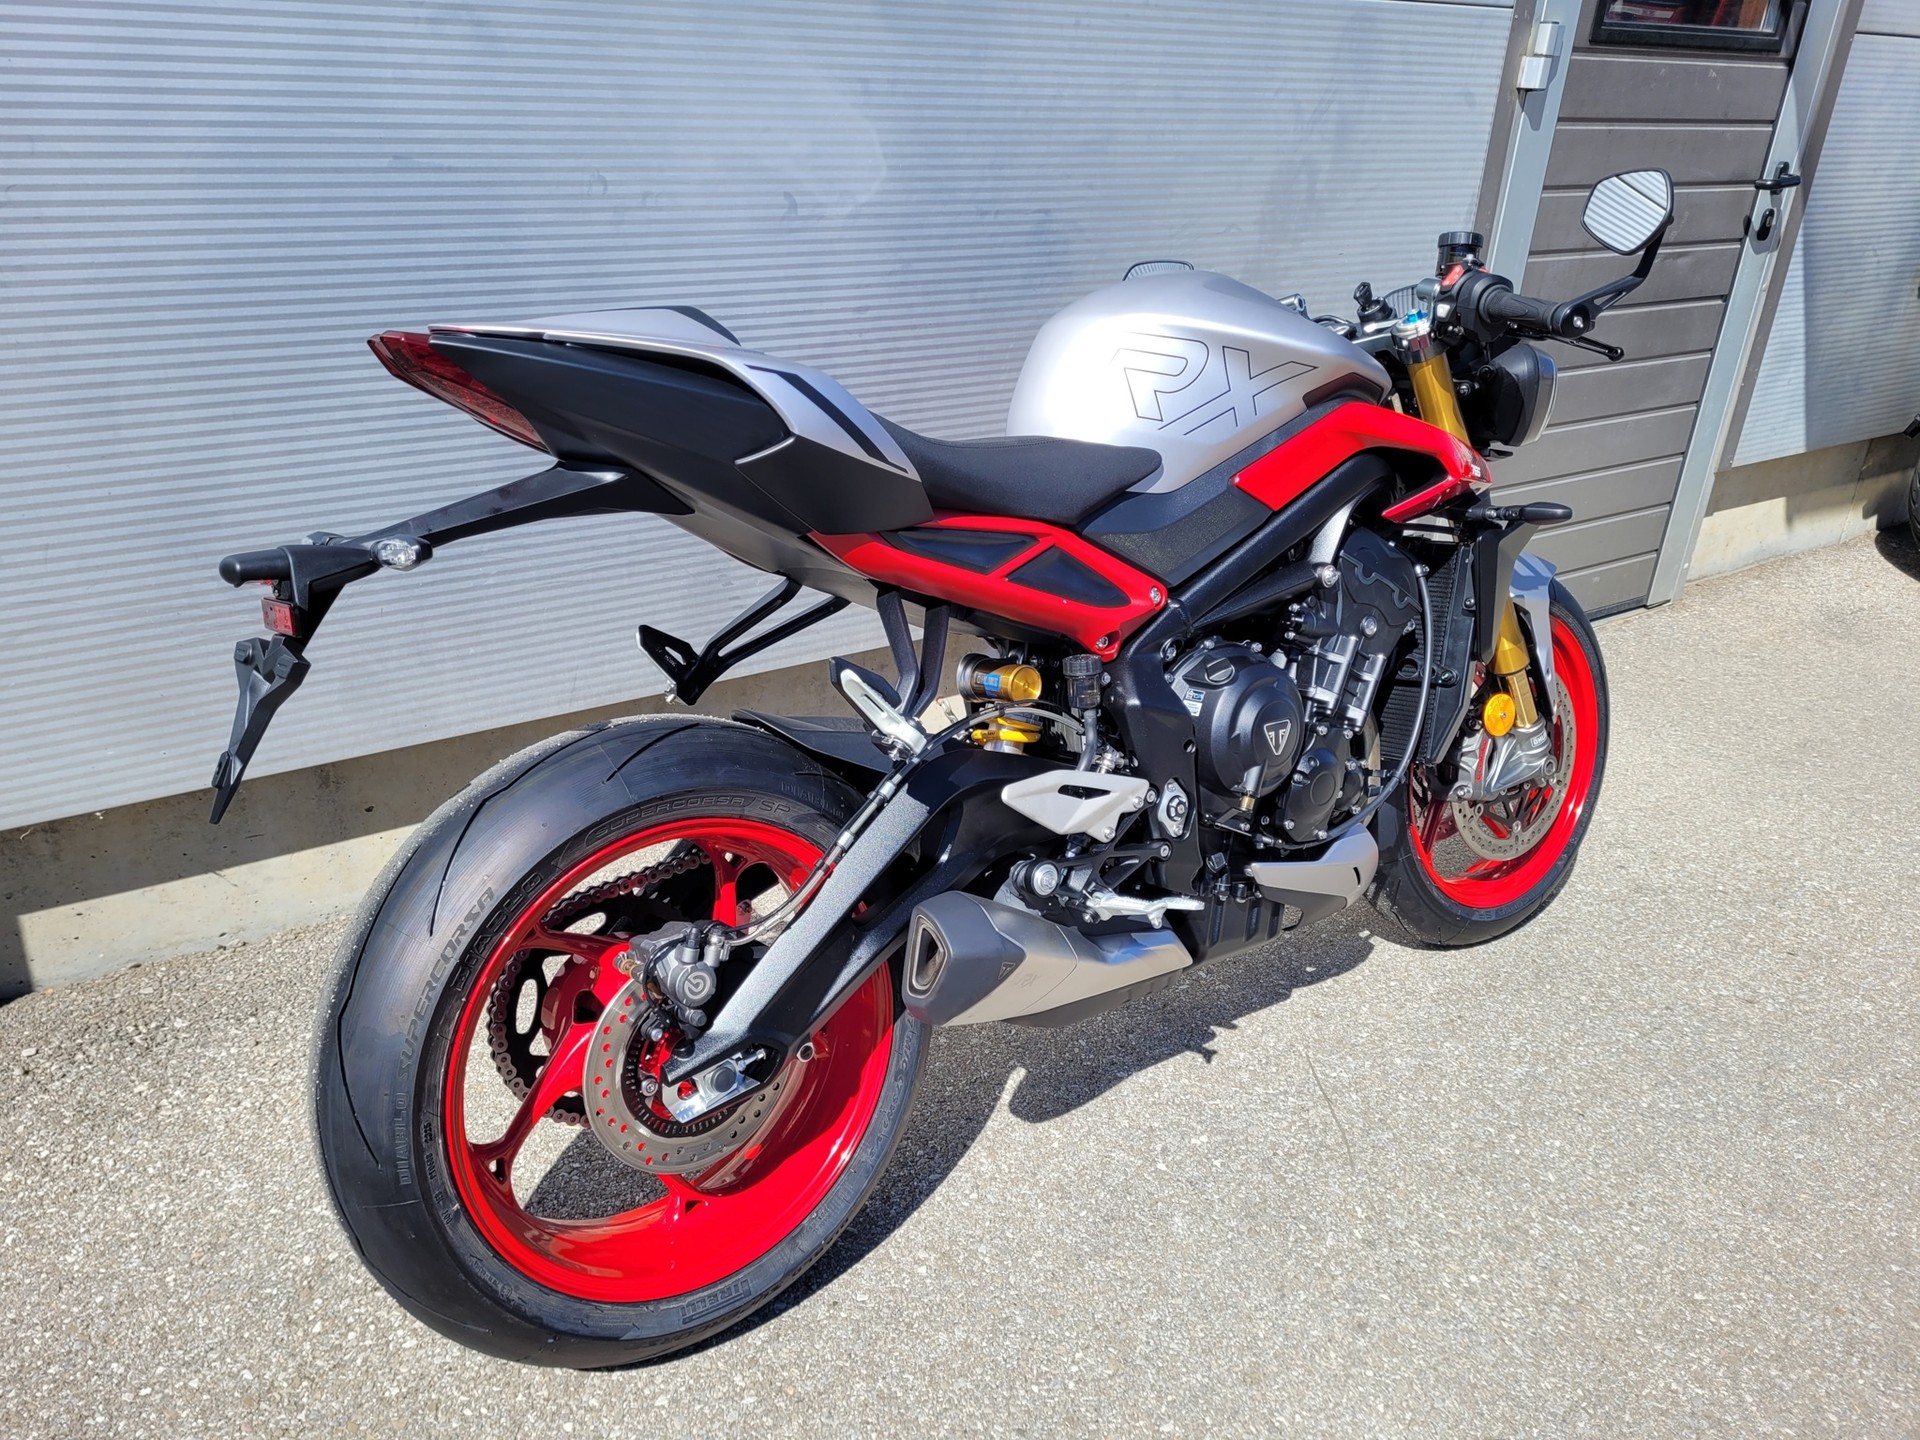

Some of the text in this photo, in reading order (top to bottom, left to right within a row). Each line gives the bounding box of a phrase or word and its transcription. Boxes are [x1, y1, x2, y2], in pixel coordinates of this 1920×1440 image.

[1108, 331, 1319, 436] RX
[593, 796, 791, 838] SUPERCORSA SP
[398, 886, 495, 1081] SUPERCORSA
[450, 872, 544, 992] DIABLO
[394, 1092, 412, 1186] DIABLO
